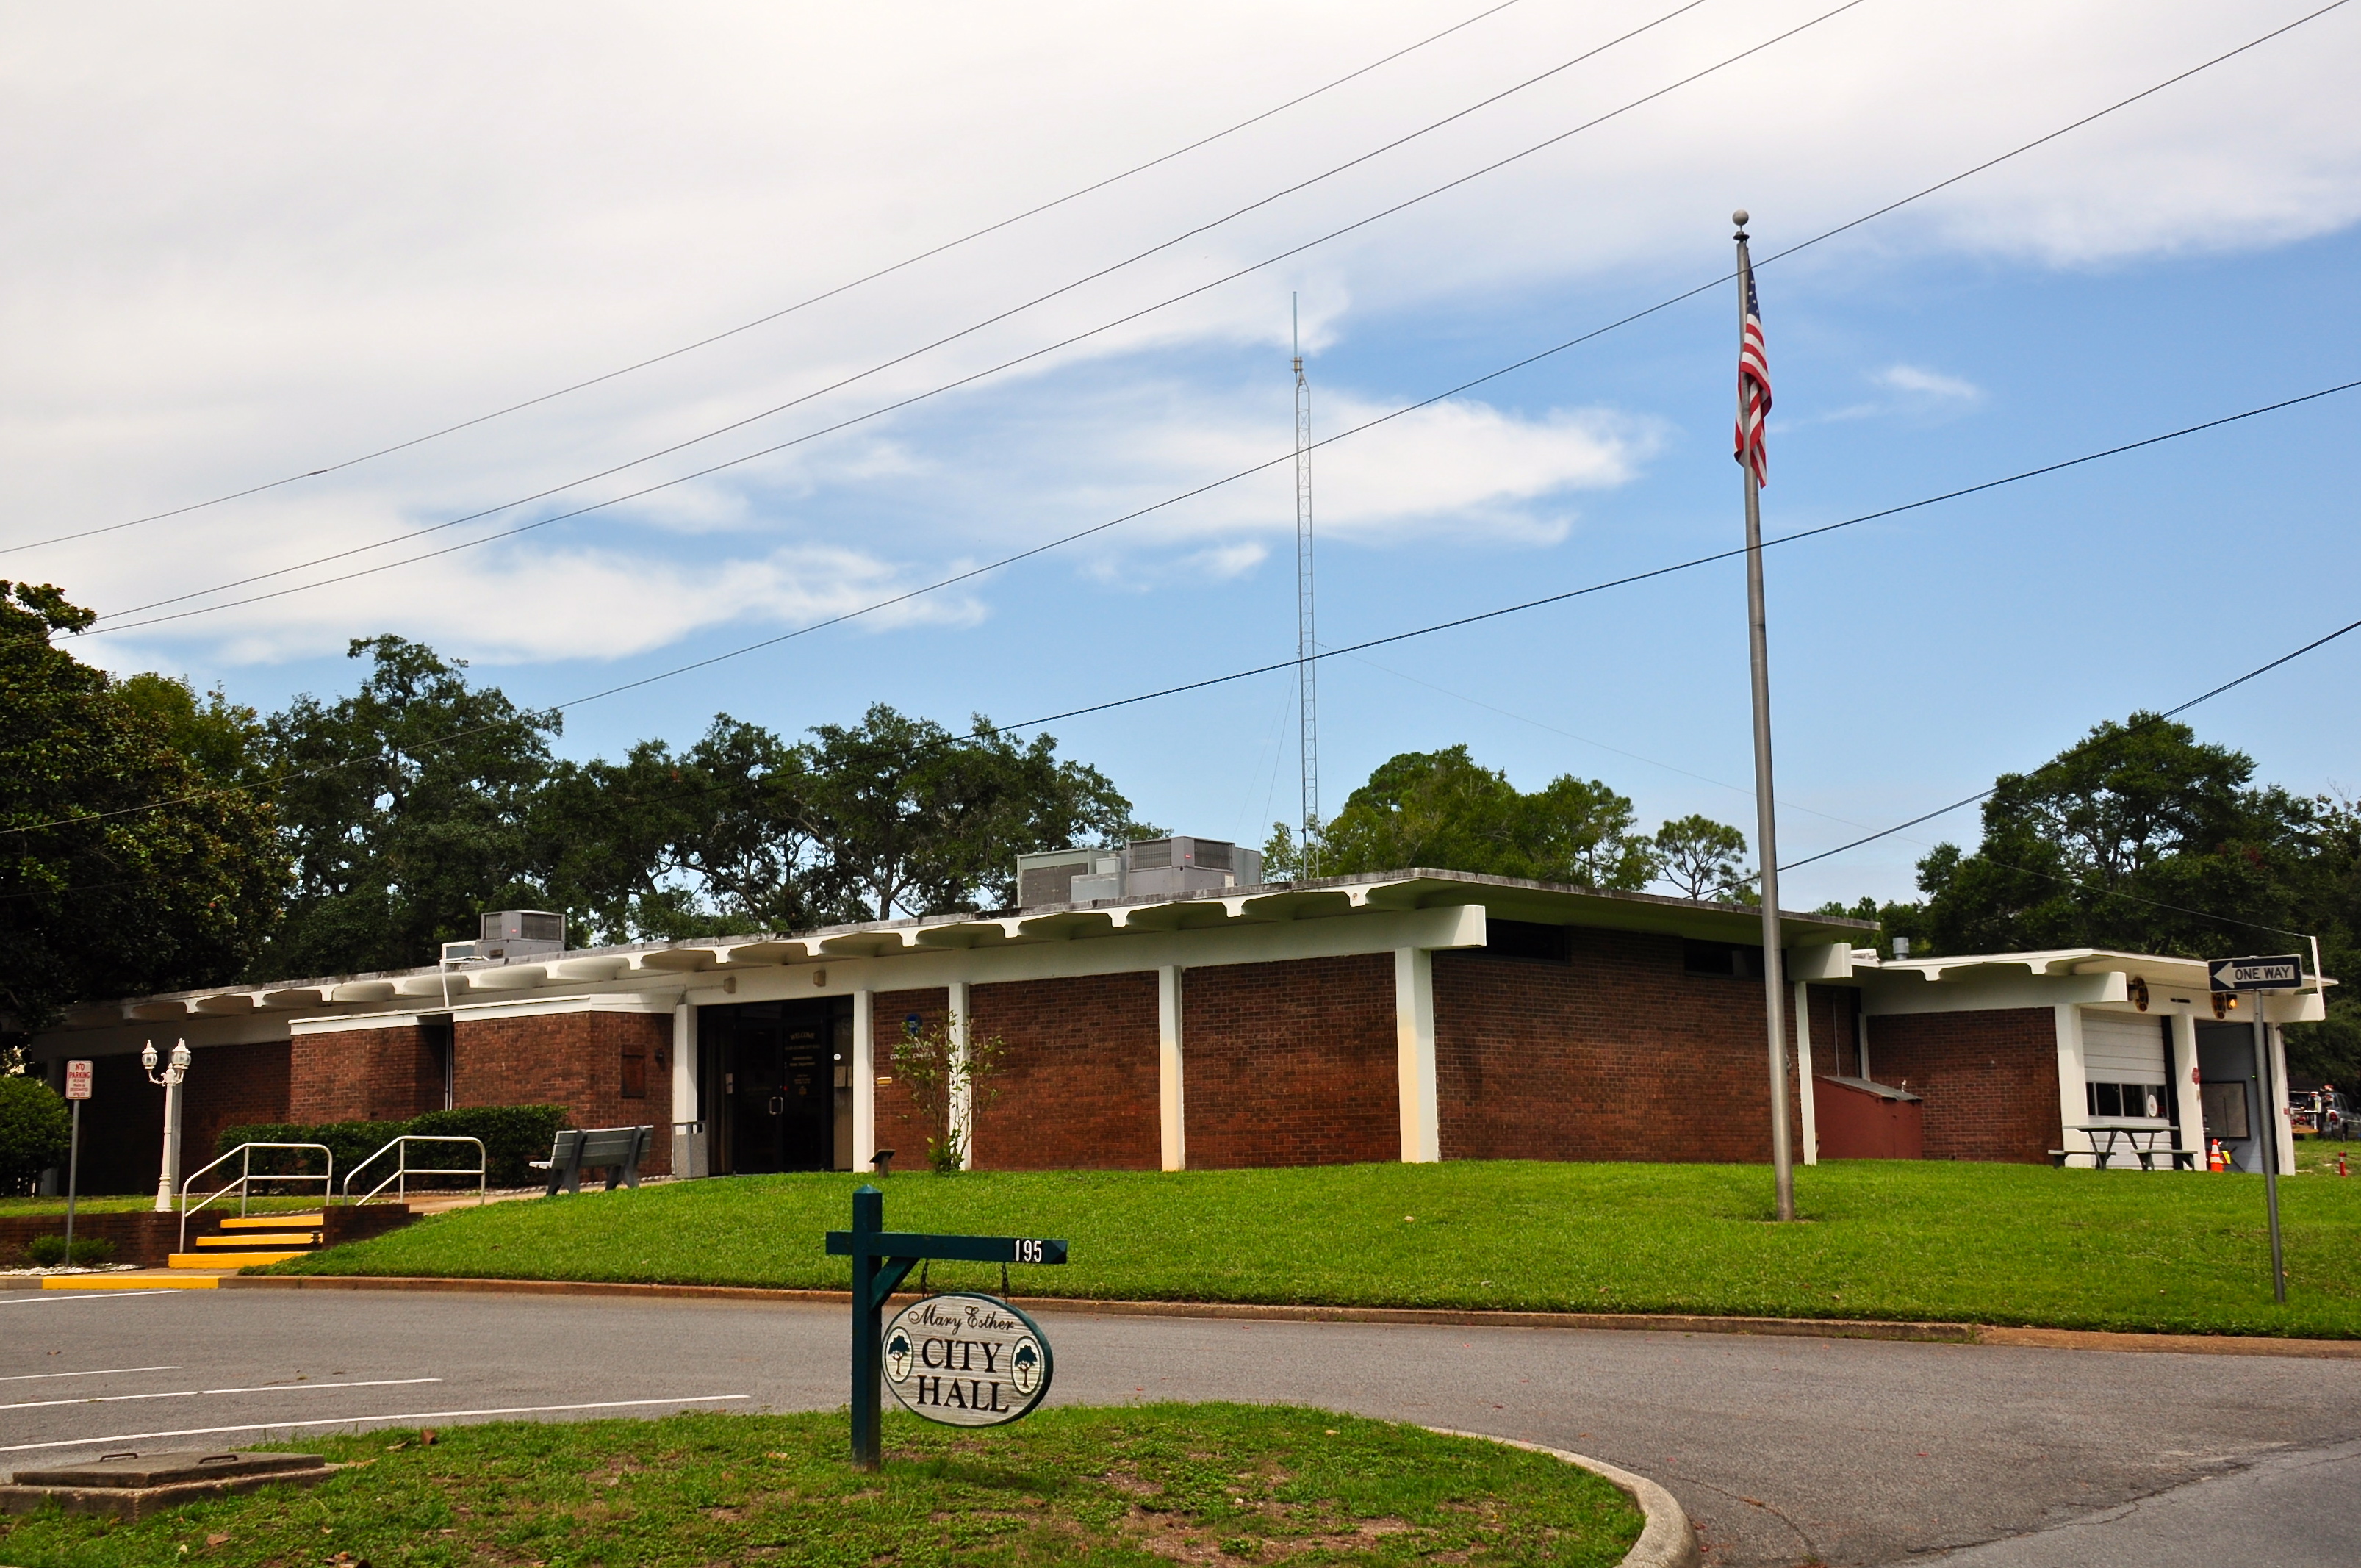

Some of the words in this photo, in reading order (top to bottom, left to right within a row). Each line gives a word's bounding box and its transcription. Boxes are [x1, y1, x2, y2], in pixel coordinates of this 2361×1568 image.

[2235, 968, 2260, 981] ONE
[2263, 966, 2290, 979] WAY
[1015, 1240, 1042, 1262] 195
[908, 1303, 963, 1335] Mary
[964, 1305, 1015, 1331] Esther
[921, 1337, 1003, 1373] CITY
[916, 1374, 1010, 1413] HALL
